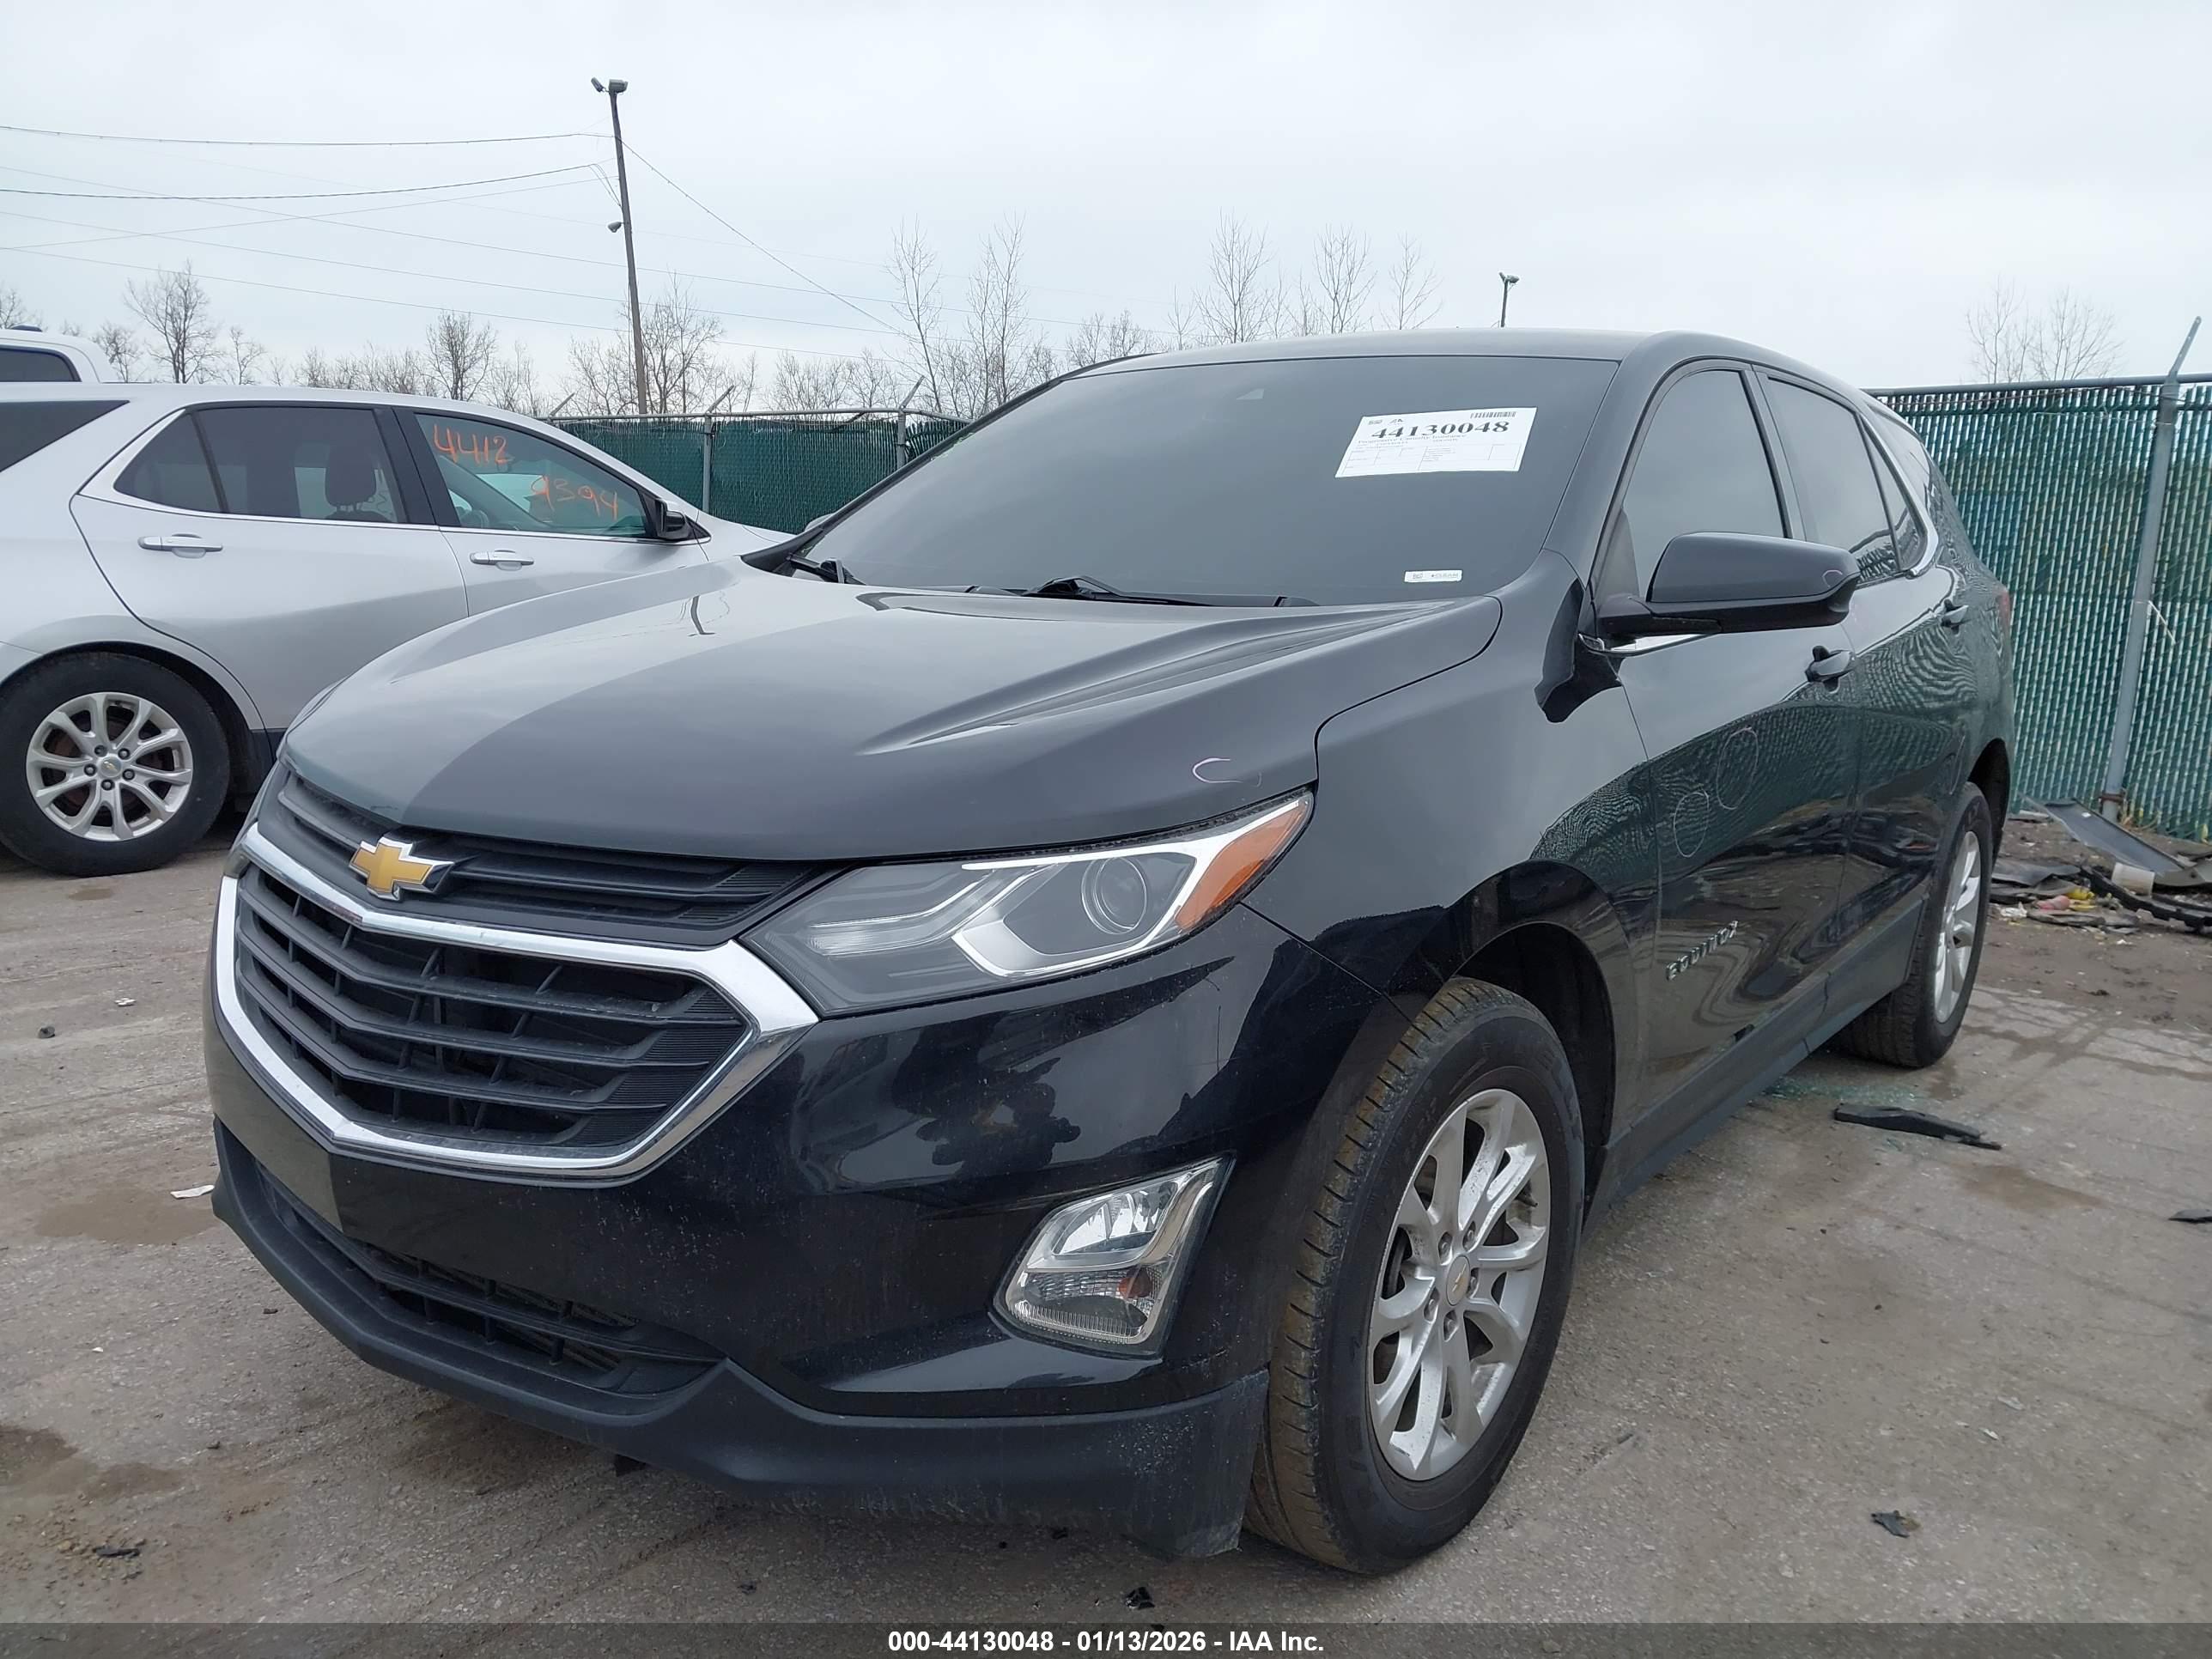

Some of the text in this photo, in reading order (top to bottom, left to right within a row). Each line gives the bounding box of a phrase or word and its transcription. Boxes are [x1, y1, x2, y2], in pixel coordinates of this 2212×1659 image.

[433, 423, 510, 465] 4412
[1371, 421, 1510, 439] 44130048
[530, 475, 618, 522] 9394
